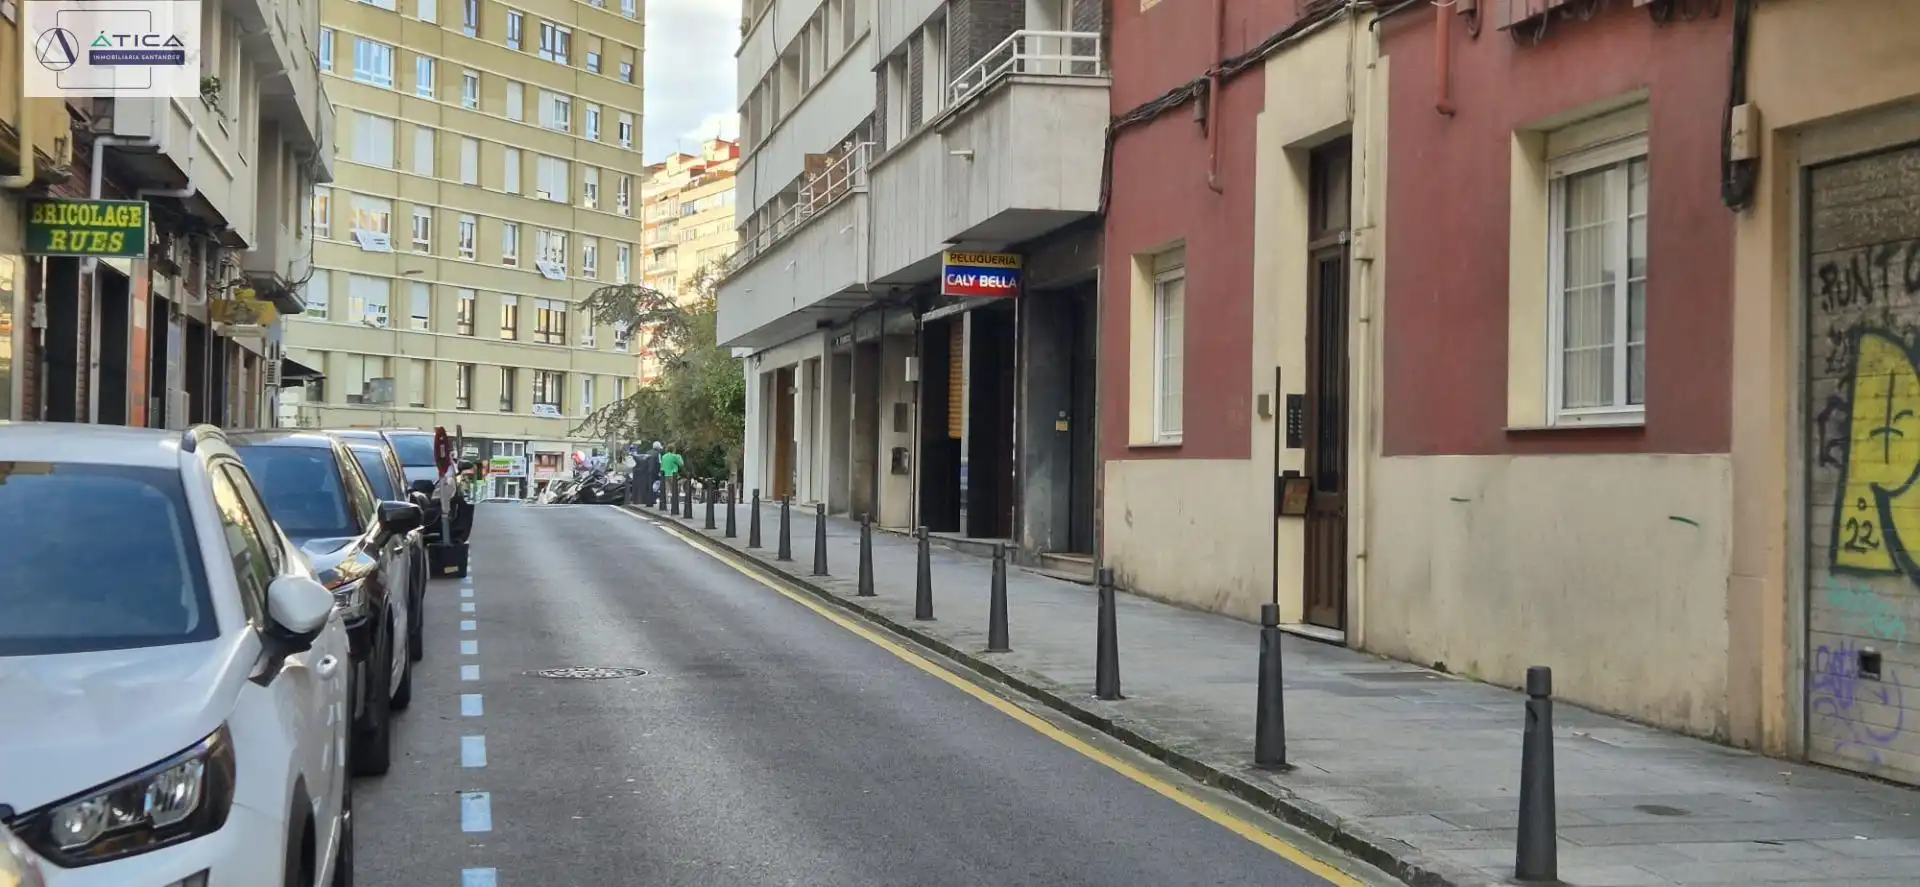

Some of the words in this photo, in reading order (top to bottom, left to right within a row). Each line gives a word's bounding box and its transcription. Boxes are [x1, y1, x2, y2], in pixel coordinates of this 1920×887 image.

[31, 203, 142, 228] BRICOLAGE
[47, 229, 124, 253] RUES
[947, 274, 976, 287] CALY
[980, 275, 1017, 288] BELLA
[1845, 516, 1880, 554] 22
